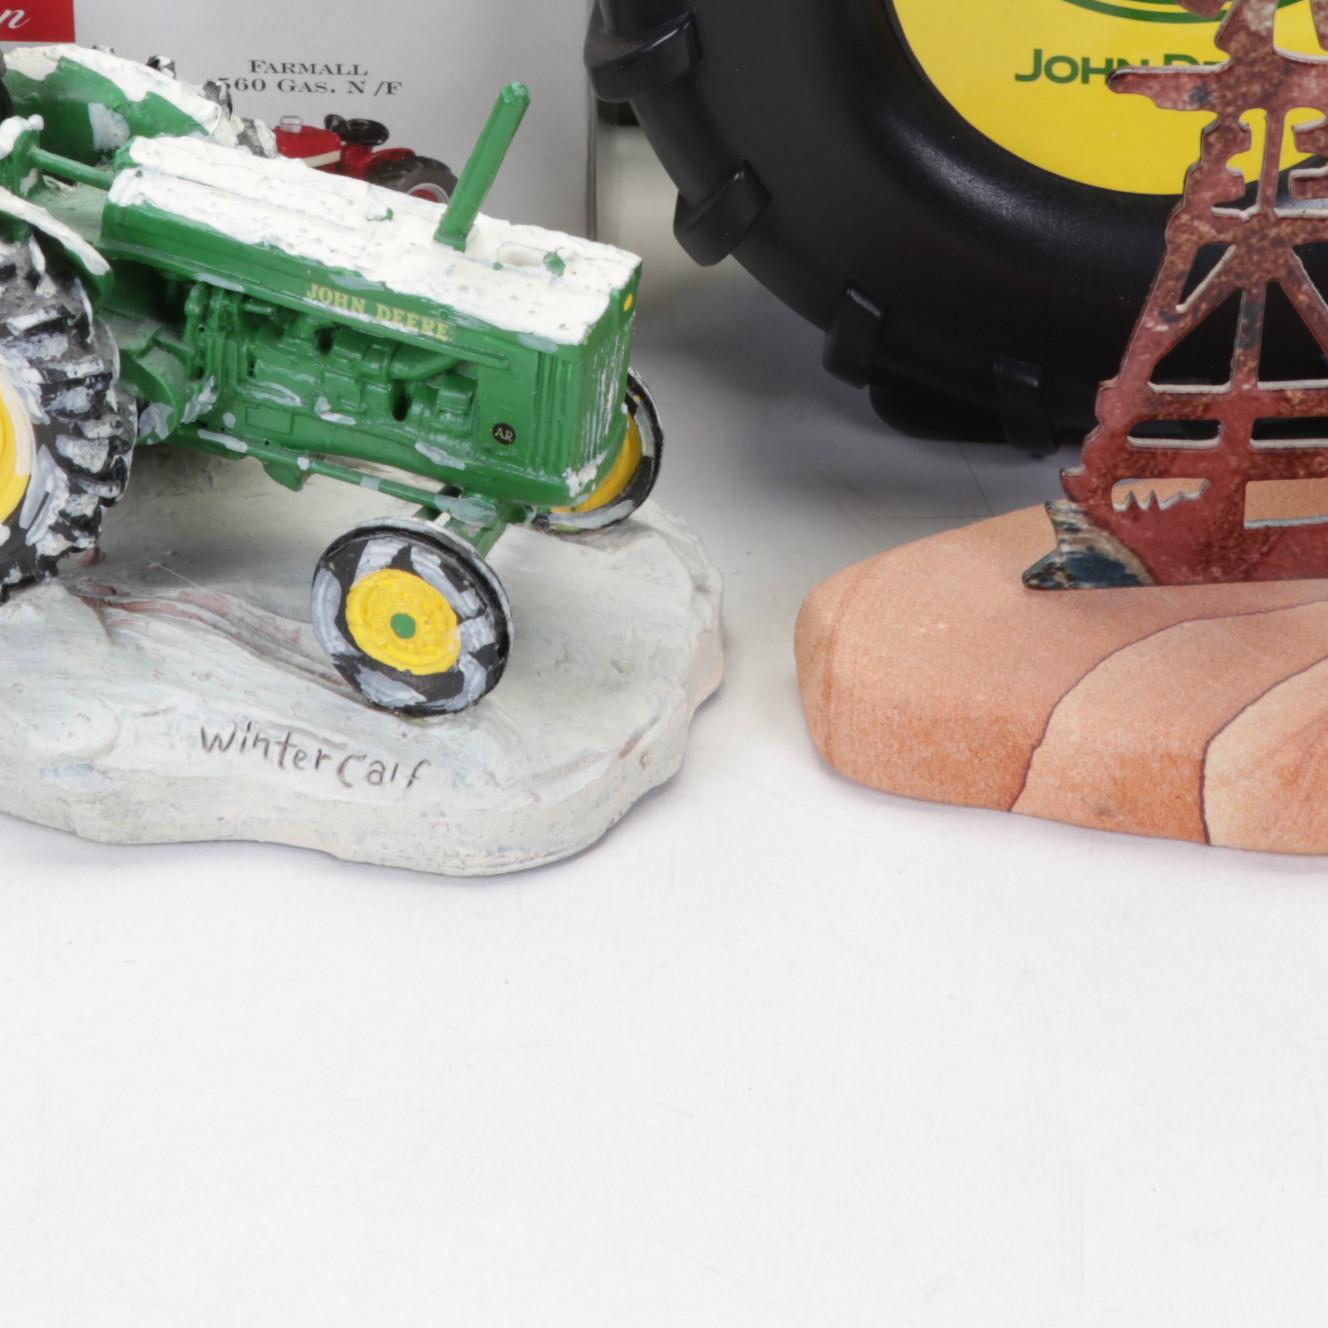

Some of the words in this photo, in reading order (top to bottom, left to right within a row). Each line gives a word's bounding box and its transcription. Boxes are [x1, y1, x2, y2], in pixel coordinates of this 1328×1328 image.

[249, 59, 369, 77] FARMALL
[306, 283, 367, 314] JOHN
[375, 303, 450, 342] DEERE
